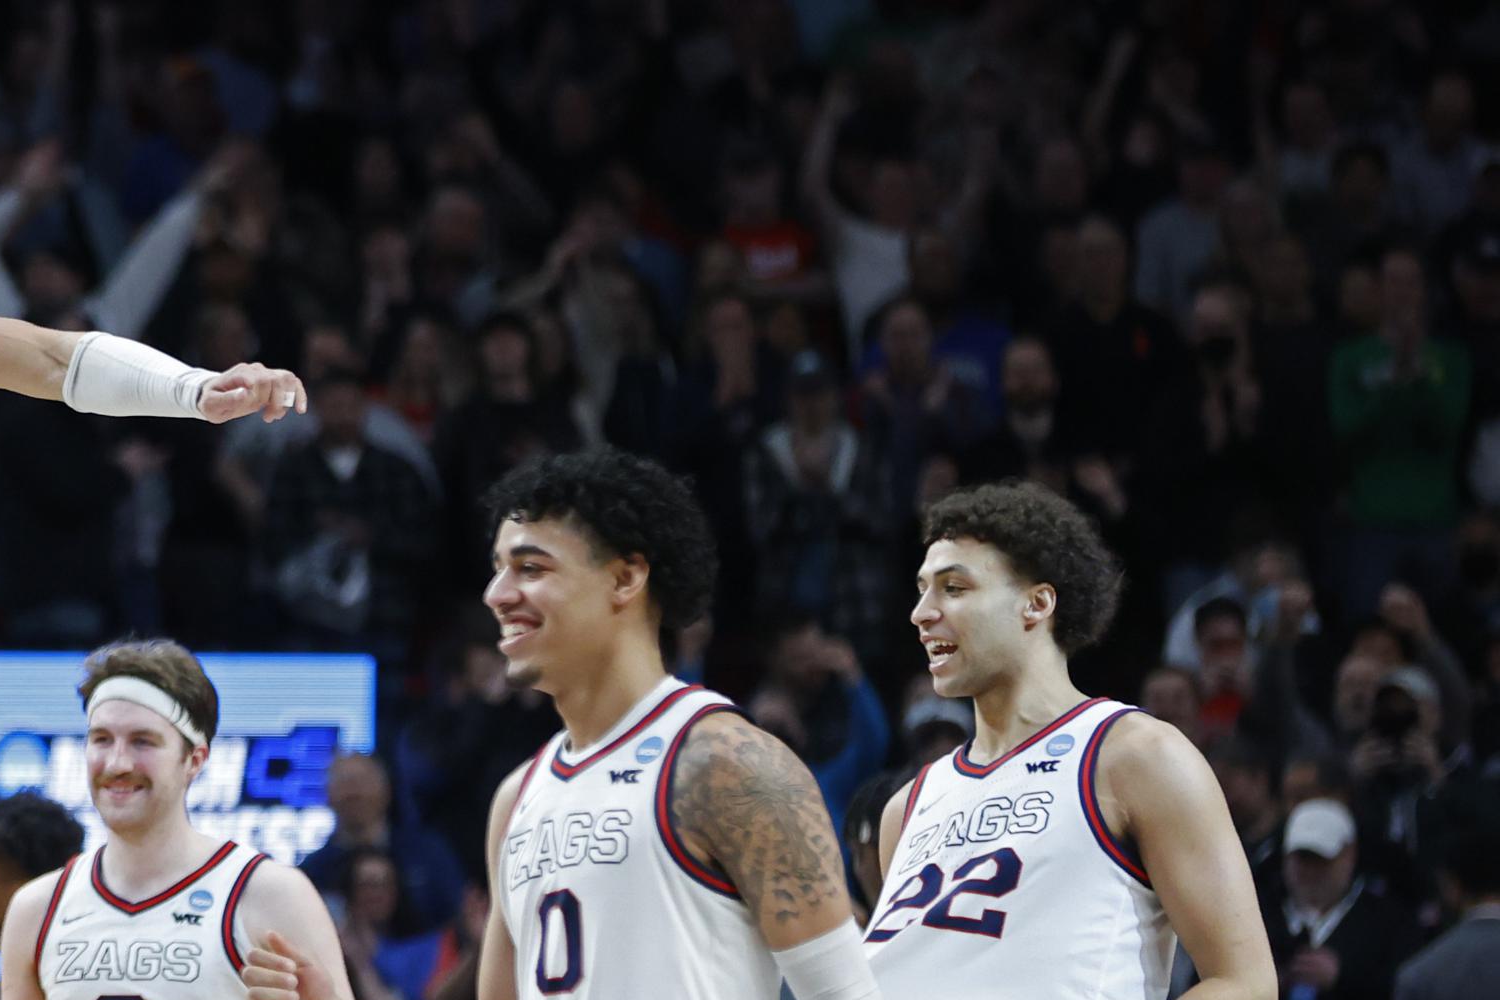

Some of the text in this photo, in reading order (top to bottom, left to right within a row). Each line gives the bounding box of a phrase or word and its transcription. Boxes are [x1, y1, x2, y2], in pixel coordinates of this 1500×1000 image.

[509, 809, 632, 891] ZAGS
[901, 791, 1054, 875] ZAGS
[864, 847, 1023, 943] 22
[54, 941, 202, 984] ZAGS
[536, 888, 583, 996] 0
